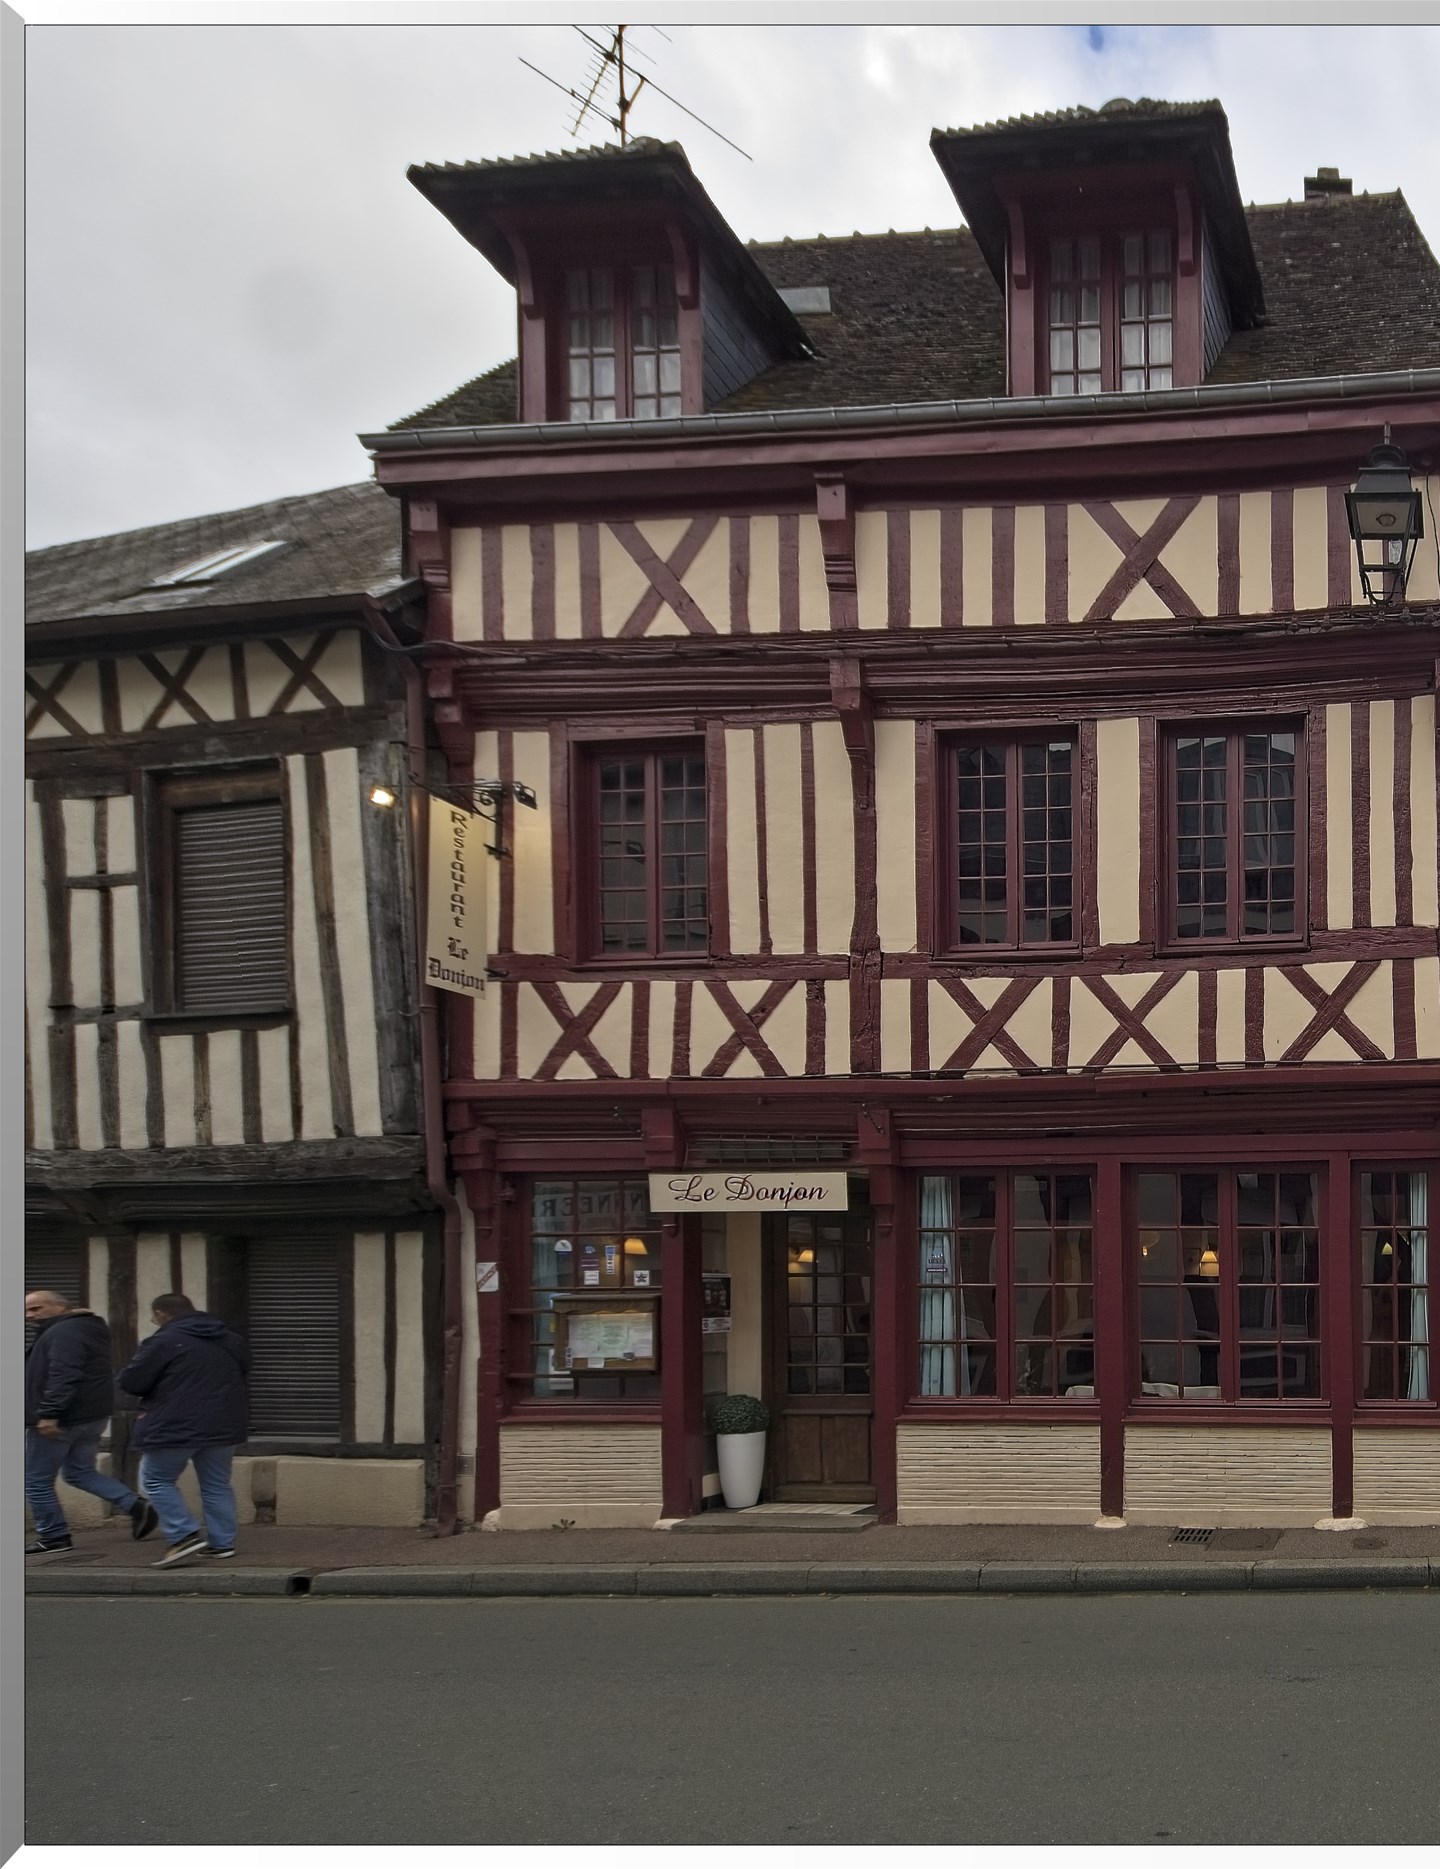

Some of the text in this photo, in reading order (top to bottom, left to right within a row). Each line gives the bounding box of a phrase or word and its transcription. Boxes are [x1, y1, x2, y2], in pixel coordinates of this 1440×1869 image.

[450, 810, 468, 929] Restaurant
[446, 936, 469, 960] Le
[428, 957, 486, 991] Donjon
[668, 1174, 829, 1209] Le Donjon
